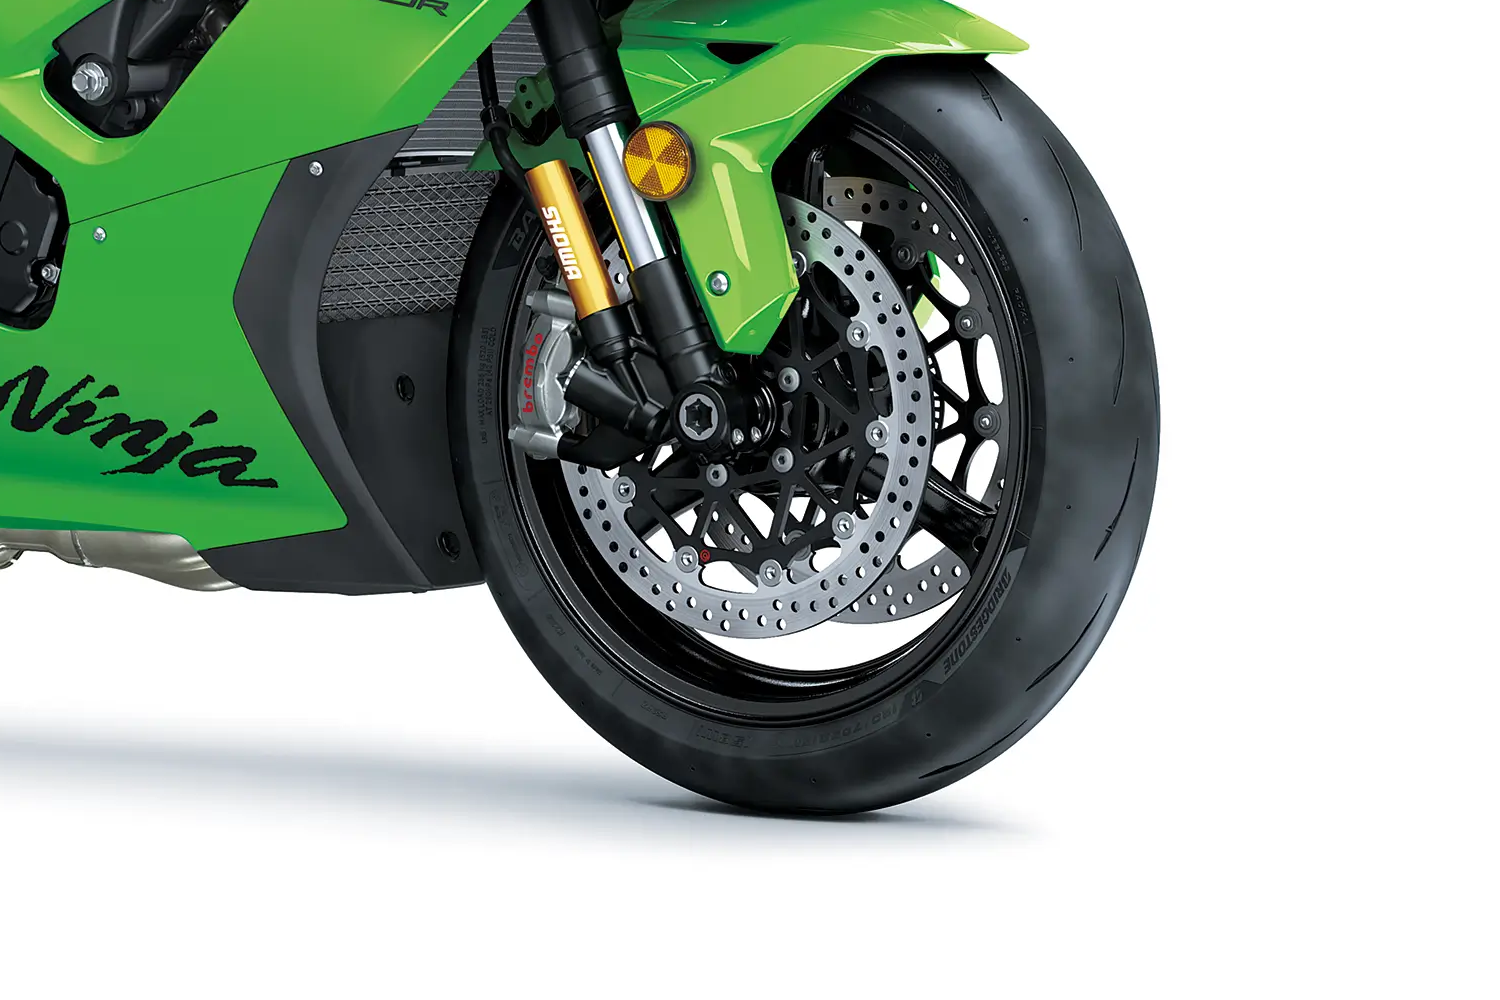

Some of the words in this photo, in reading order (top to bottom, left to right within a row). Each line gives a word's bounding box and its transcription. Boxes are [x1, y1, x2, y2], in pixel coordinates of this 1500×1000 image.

[542, 205, 582, 281] SHOWA
[522, 332, 544, 414] brembo
[943, 567, 1013, 676] BRIDGESTONE
